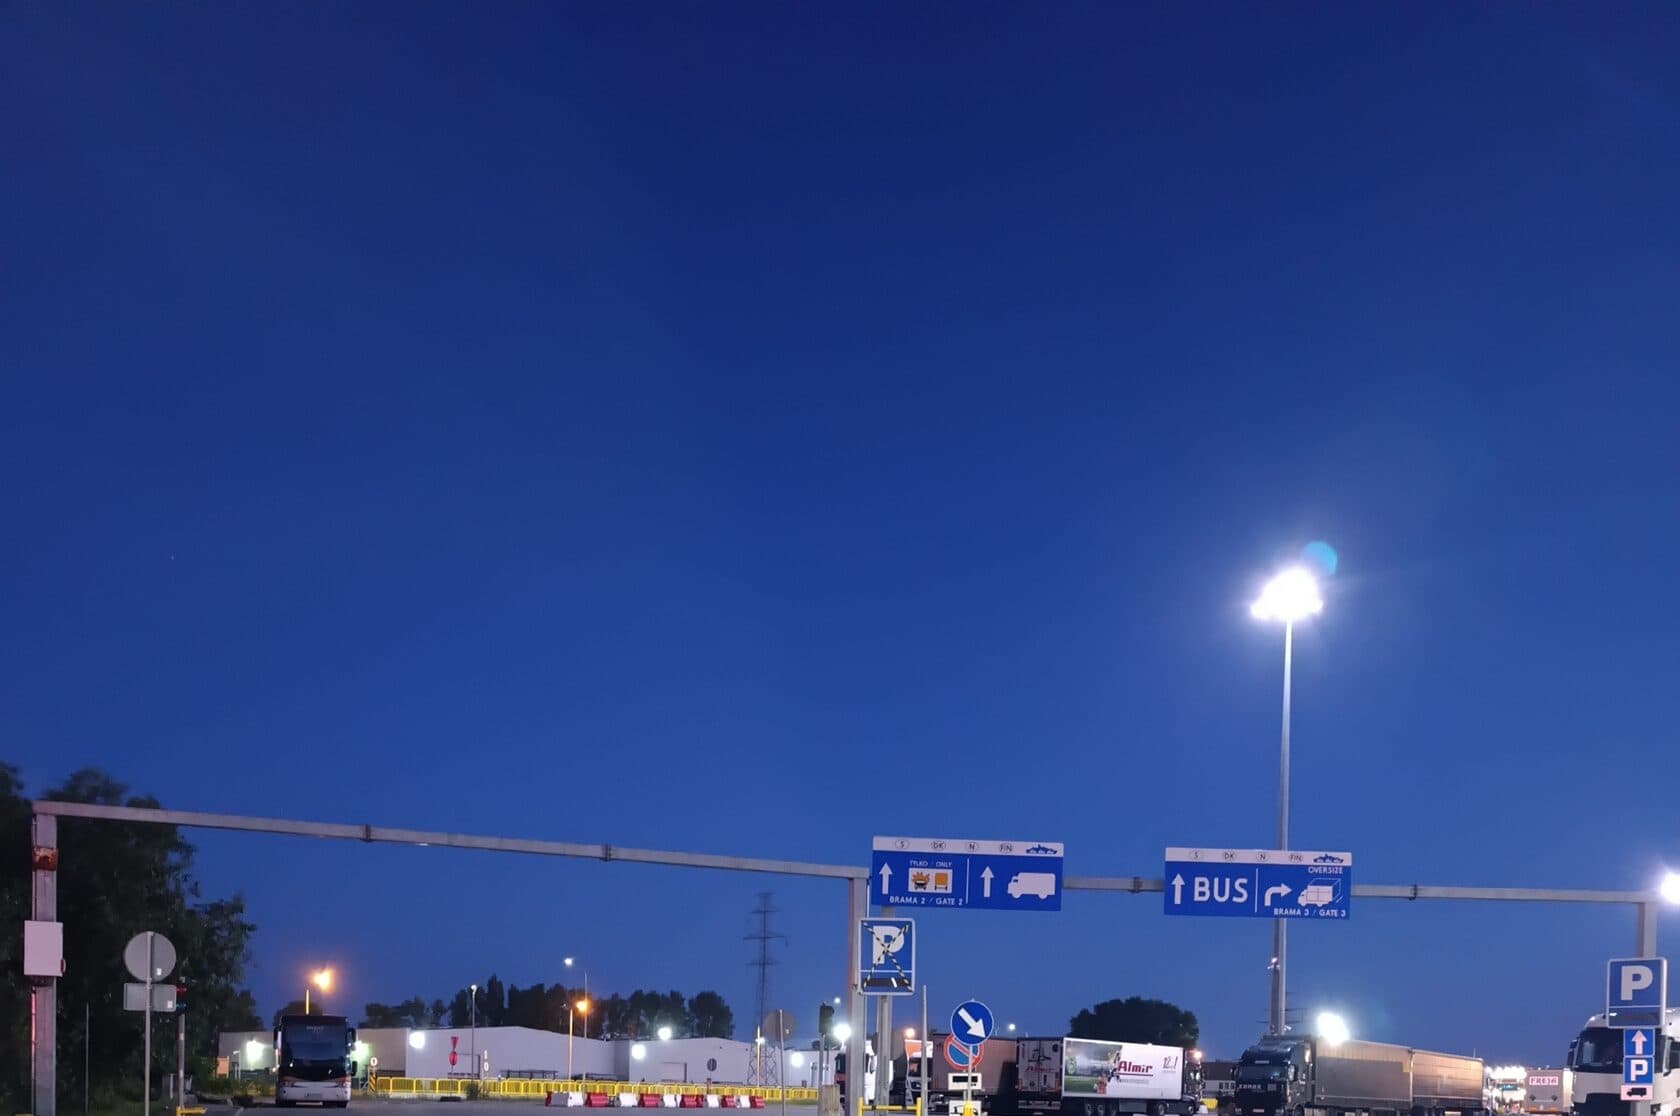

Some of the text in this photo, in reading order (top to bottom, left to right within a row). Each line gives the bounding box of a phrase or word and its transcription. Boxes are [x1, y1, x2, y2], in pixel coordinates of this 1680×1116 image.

[933, 841, 944, 849] DK
[1308, 866, 1343, 874] OVERSIZE
[1194, 876, 1248, 903] BUS
[889, 896, 917, 904] BRAMA
[935, 897, 955, 905] GATE
[1273, 908, 1301, 916] BRAMA
[1319, 909, 1338, 917] GATE
[873, 925, 905, 964] P
[1620, 965, 1653, 1001] P
[1118, 1060, 1153, 1073] Almir
[1630, 1059, 1648, 1081] P
